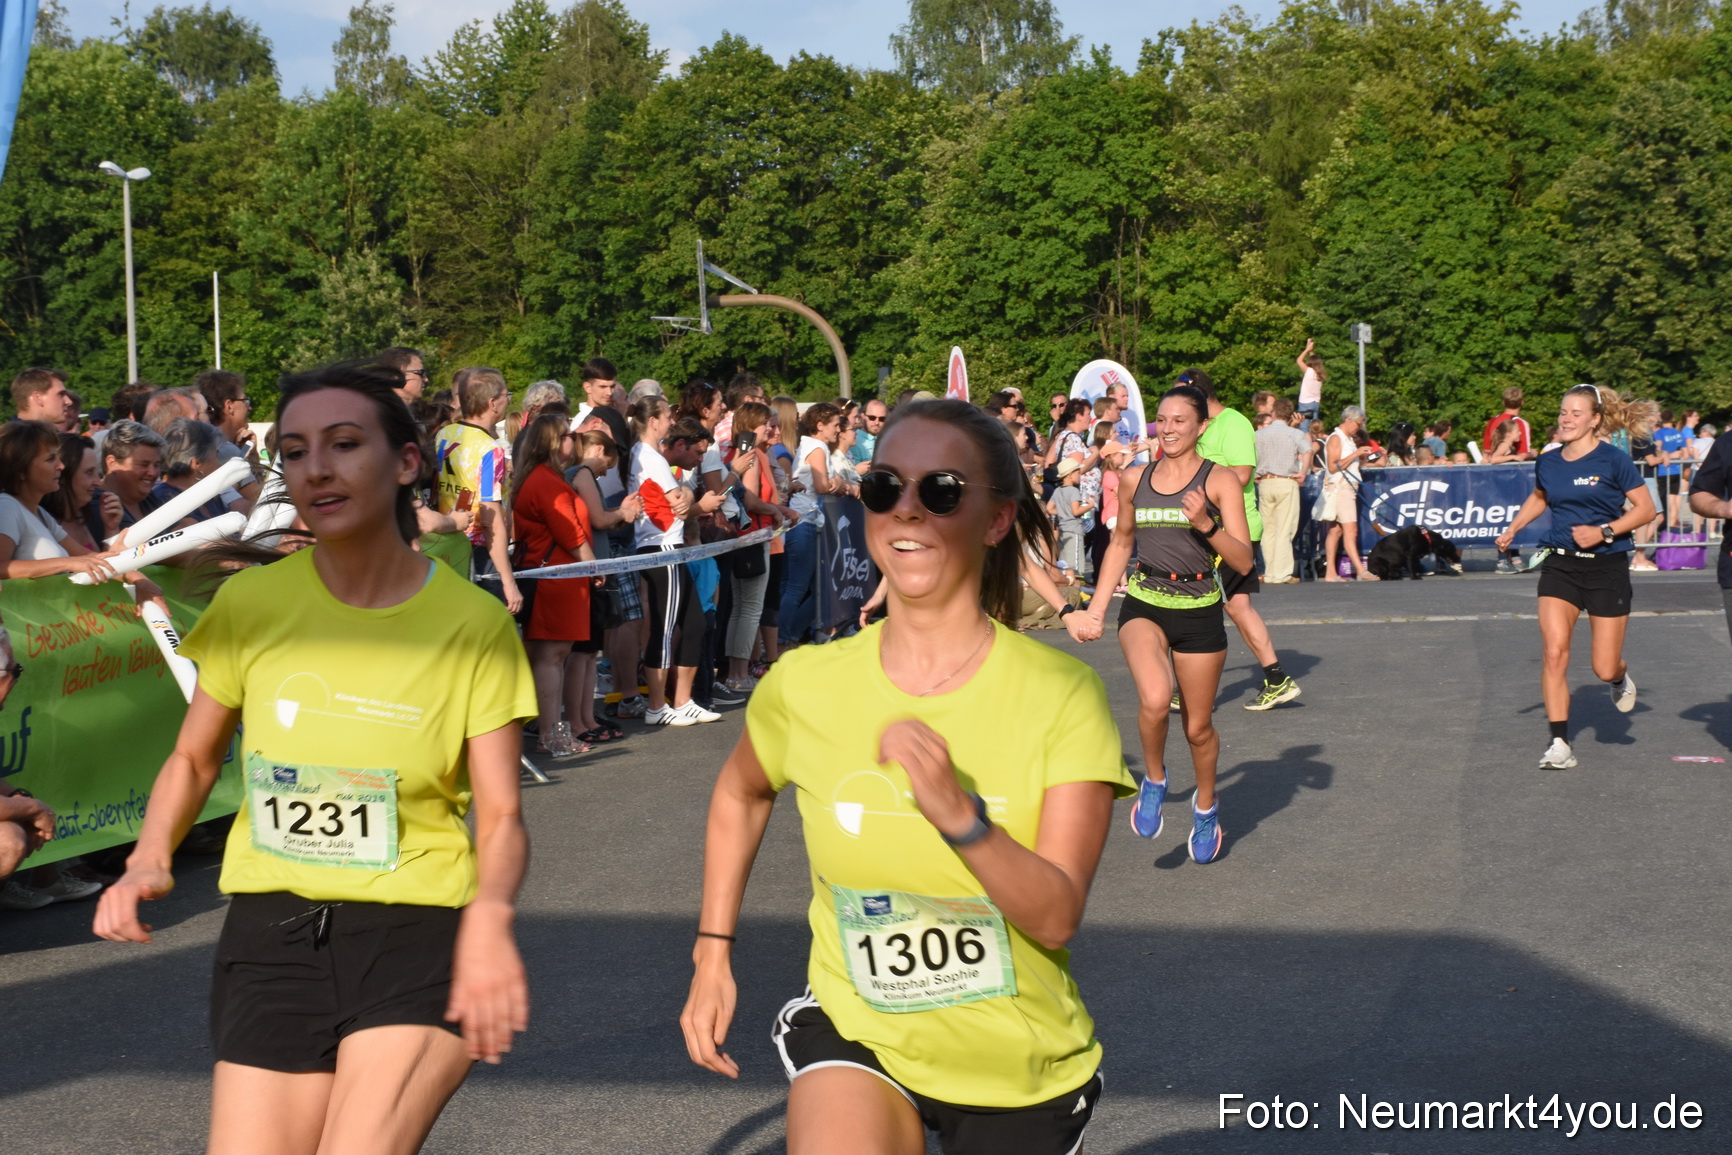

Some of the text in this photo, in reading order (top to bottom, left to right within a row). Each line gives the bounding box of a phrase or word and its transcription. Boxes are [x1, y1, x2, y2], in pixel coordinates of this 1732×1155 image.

[1573, 476, 1590, 486] vhs
[1397, 500, 1521, 527] Fischer
[26, 601, 105, 659] Gesunde
[62, 646, 122, 696] laufen
[264, 796, 369, 838] 1231
[326, 839, 354, 848] Julia
[857, 927, 986, 977] 1306
[870, 968, 980, 992] Westphal Sophie
[884, 991, 921, 1001] Klinikum
[924, 983, 968, 997] Neumarkt
